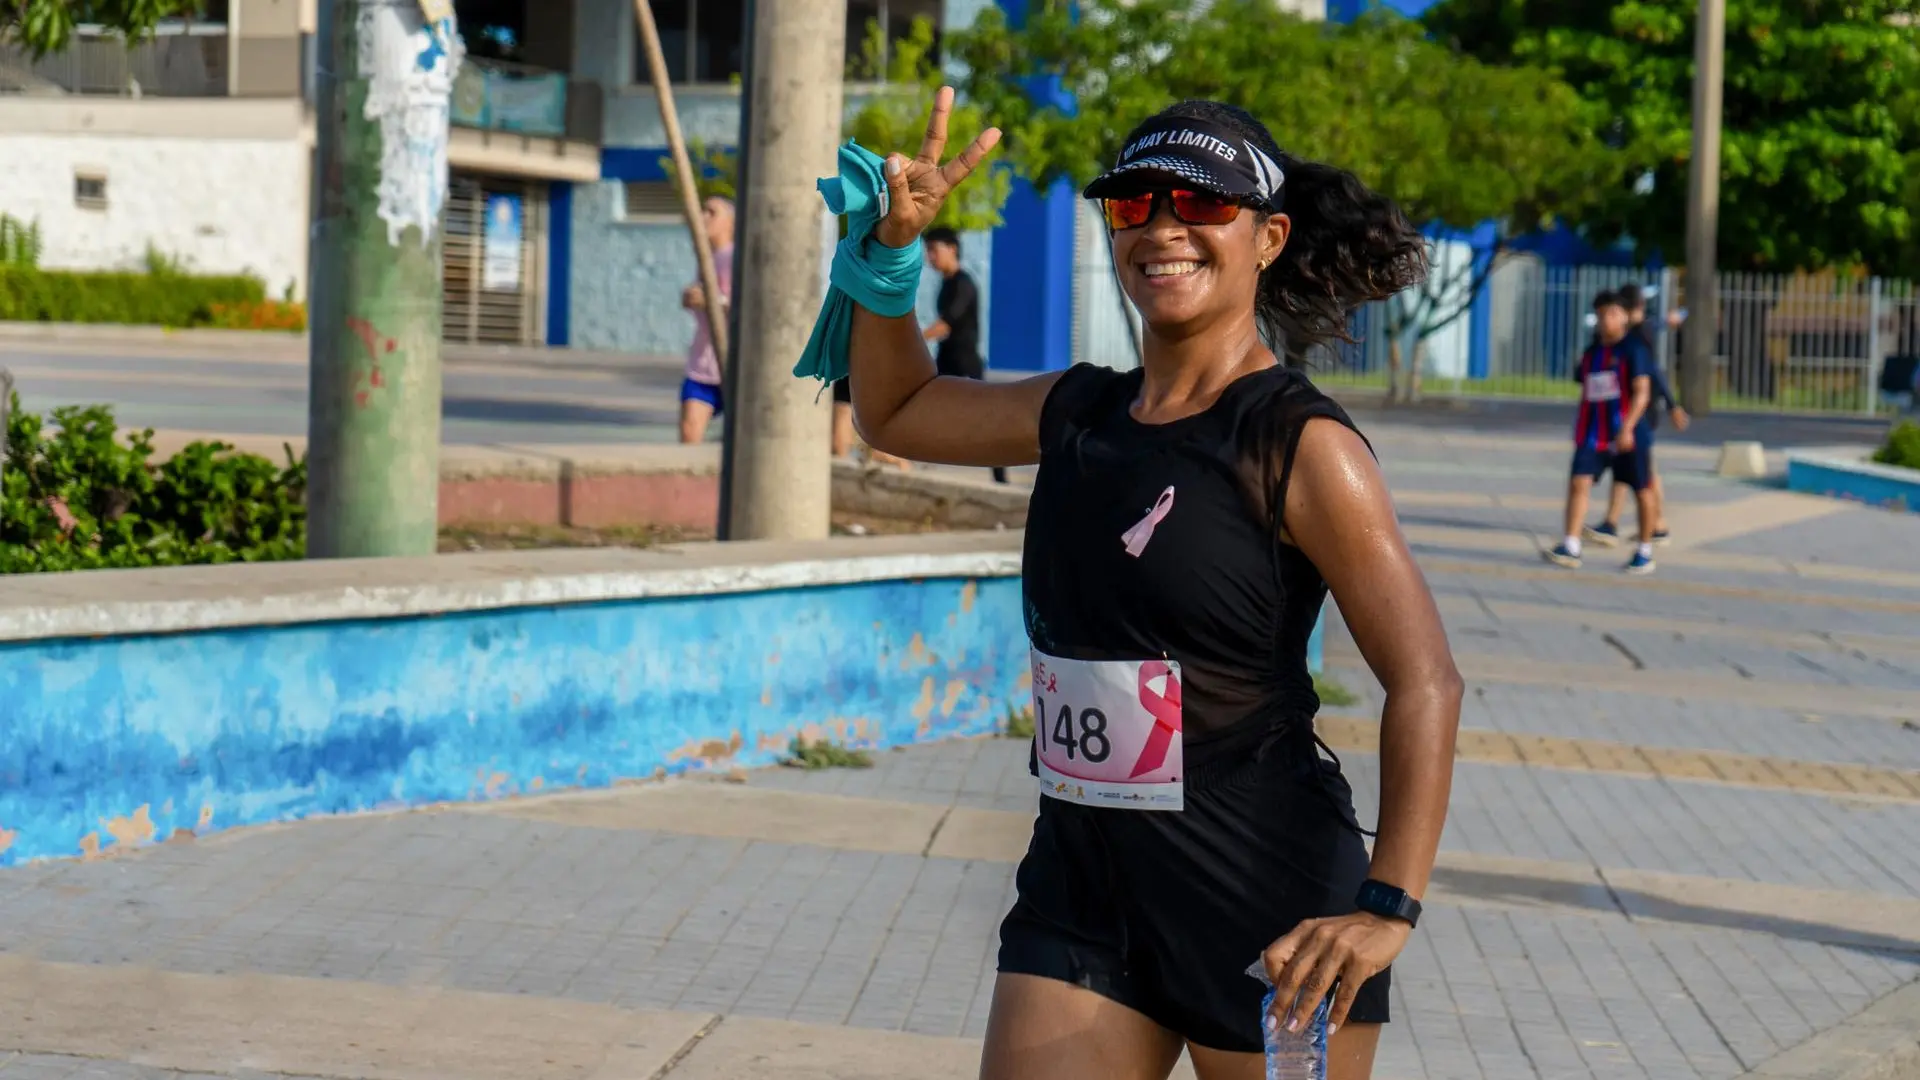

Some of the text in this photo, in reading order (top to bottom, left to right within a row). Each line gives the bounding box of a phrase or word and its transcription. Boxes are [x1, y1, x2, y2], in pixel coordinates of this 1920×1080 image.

[1135, 131, 1167, 153] HAY
[1167, 129, 1238, 162] LÍMITES
[1037, 696, 1111, 763] 148
